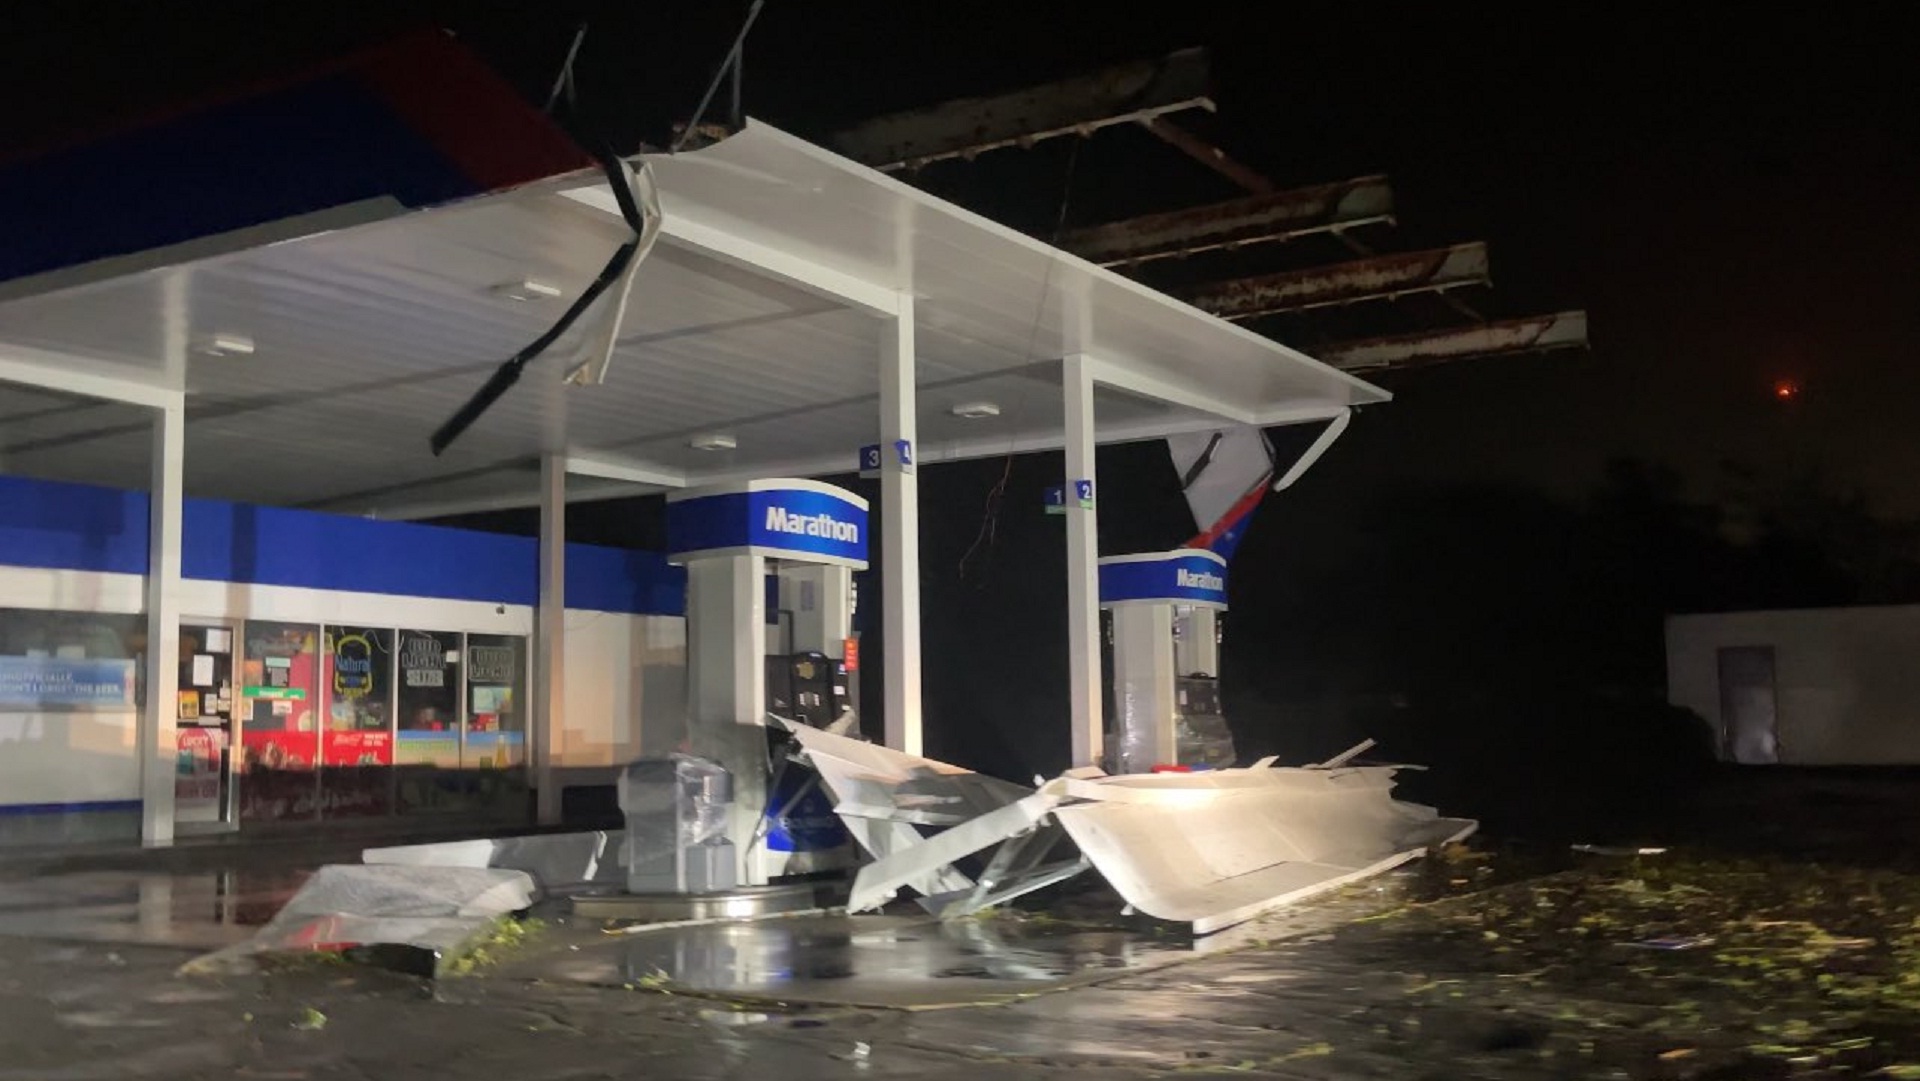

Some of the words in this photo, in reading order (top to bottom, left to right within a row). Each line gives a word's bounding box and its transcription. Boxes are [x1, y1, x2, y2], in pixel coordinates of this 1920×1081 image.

[868, 449, 880, 468] 3
[1052, 489, 1063, 505] 1
[1082, 484, 1092, 500] 2
[765, 505, 859, 544] Marathon
[1176, 568, 1223, 591] Marathon
[335, 654, 371, 672] Natural
